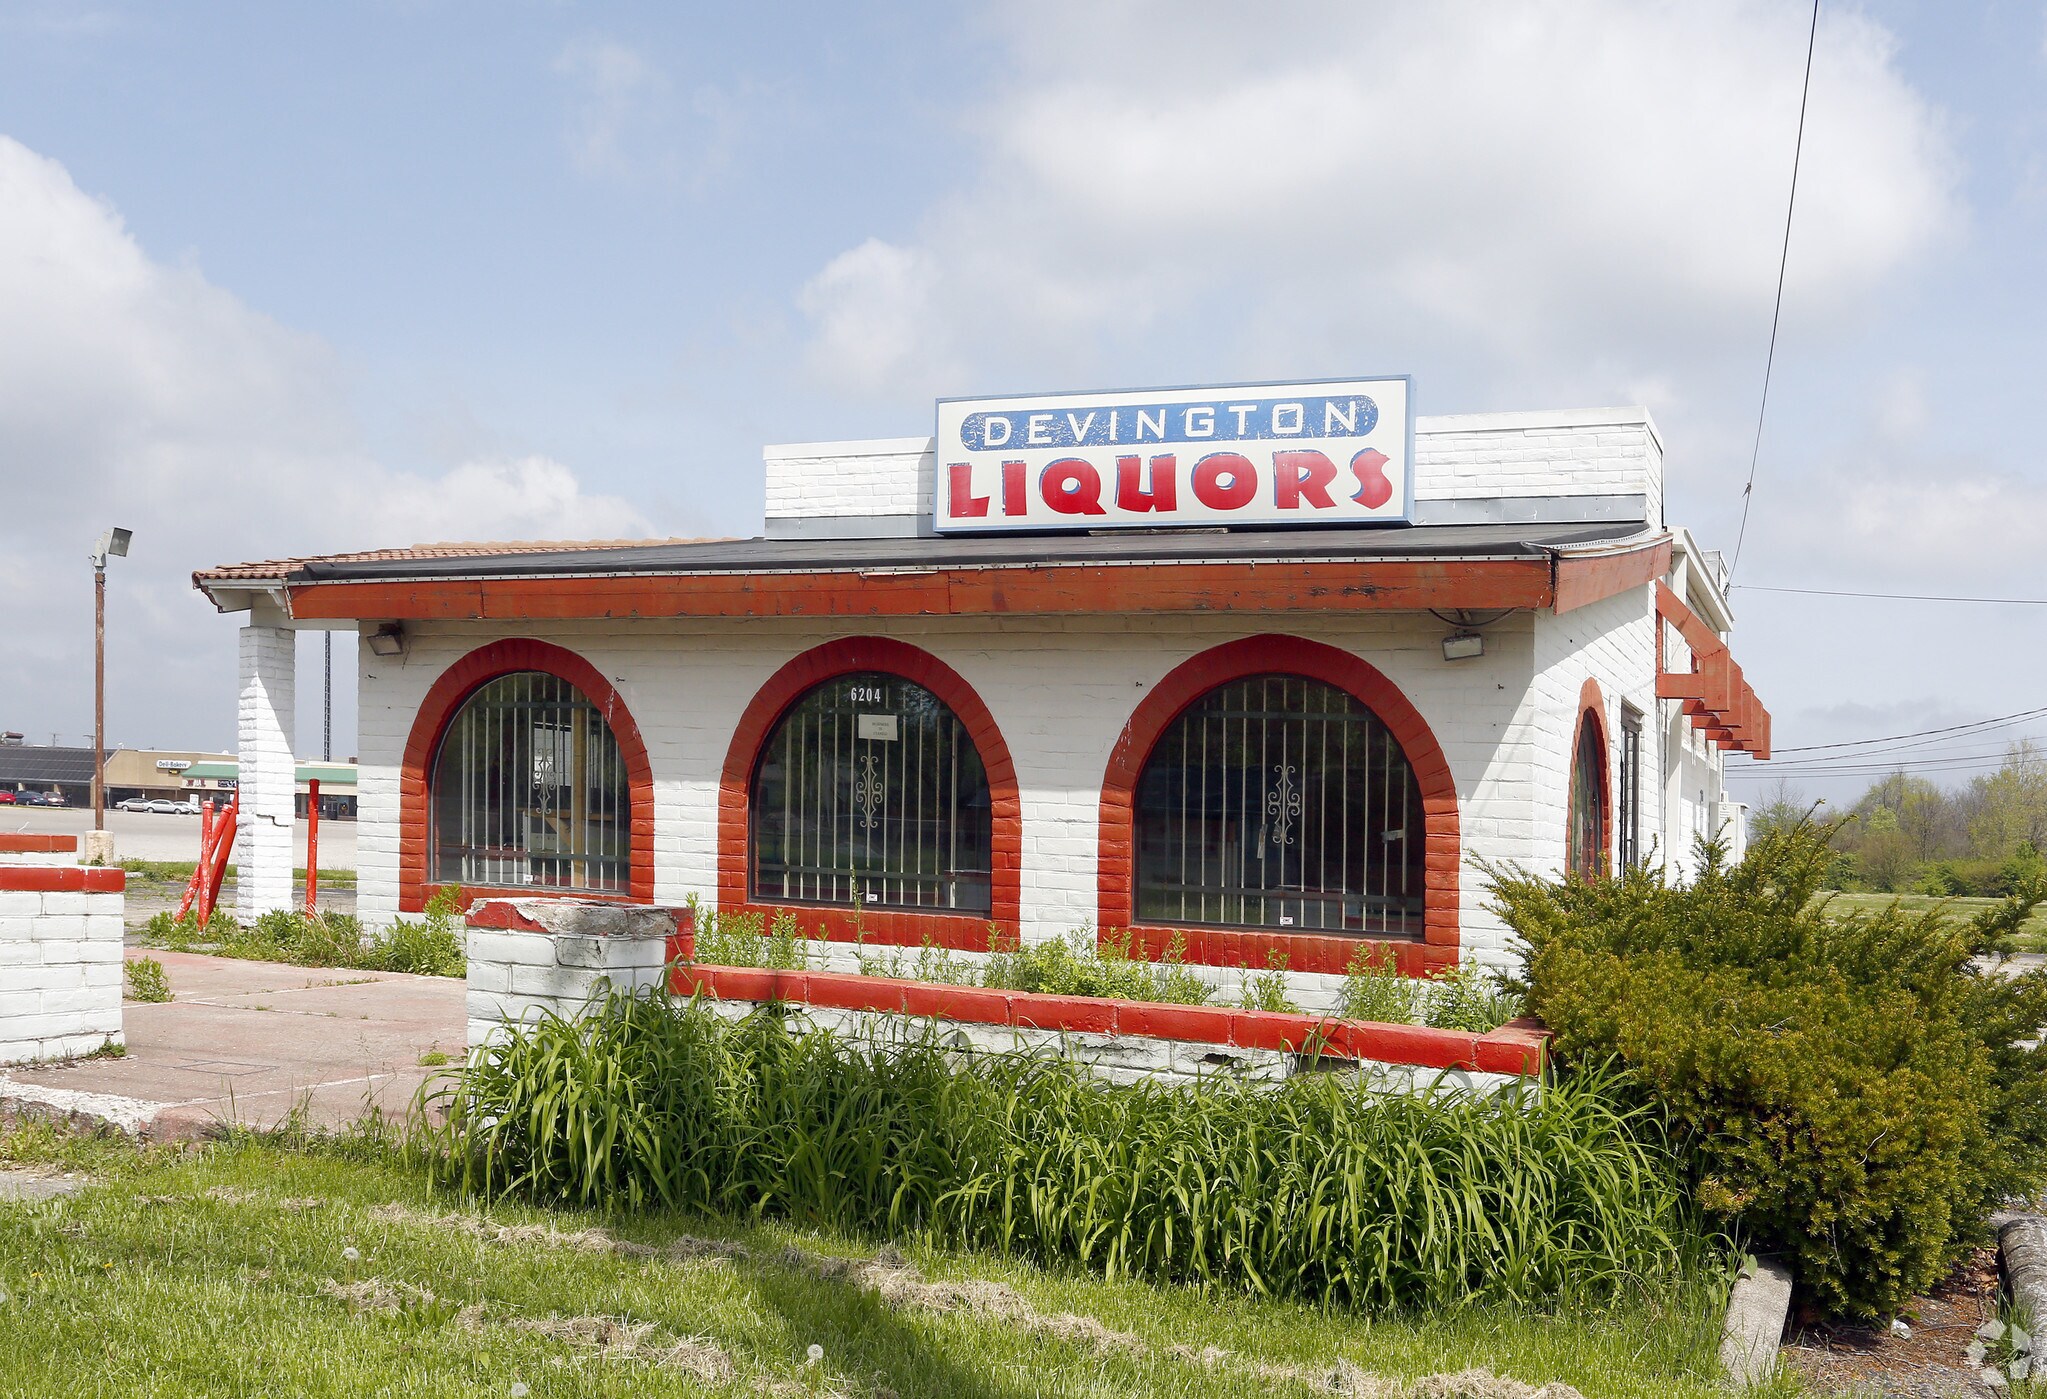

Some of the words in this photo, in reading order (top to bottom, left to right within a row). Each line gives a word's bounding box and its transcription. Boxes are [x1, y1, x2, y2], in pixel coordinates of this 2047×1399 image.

[983, 400, 1357, 446] DEVINGTON
[946, 446, 1394, 518] LIQUORS
[850, 687, 881, 702] 6204
